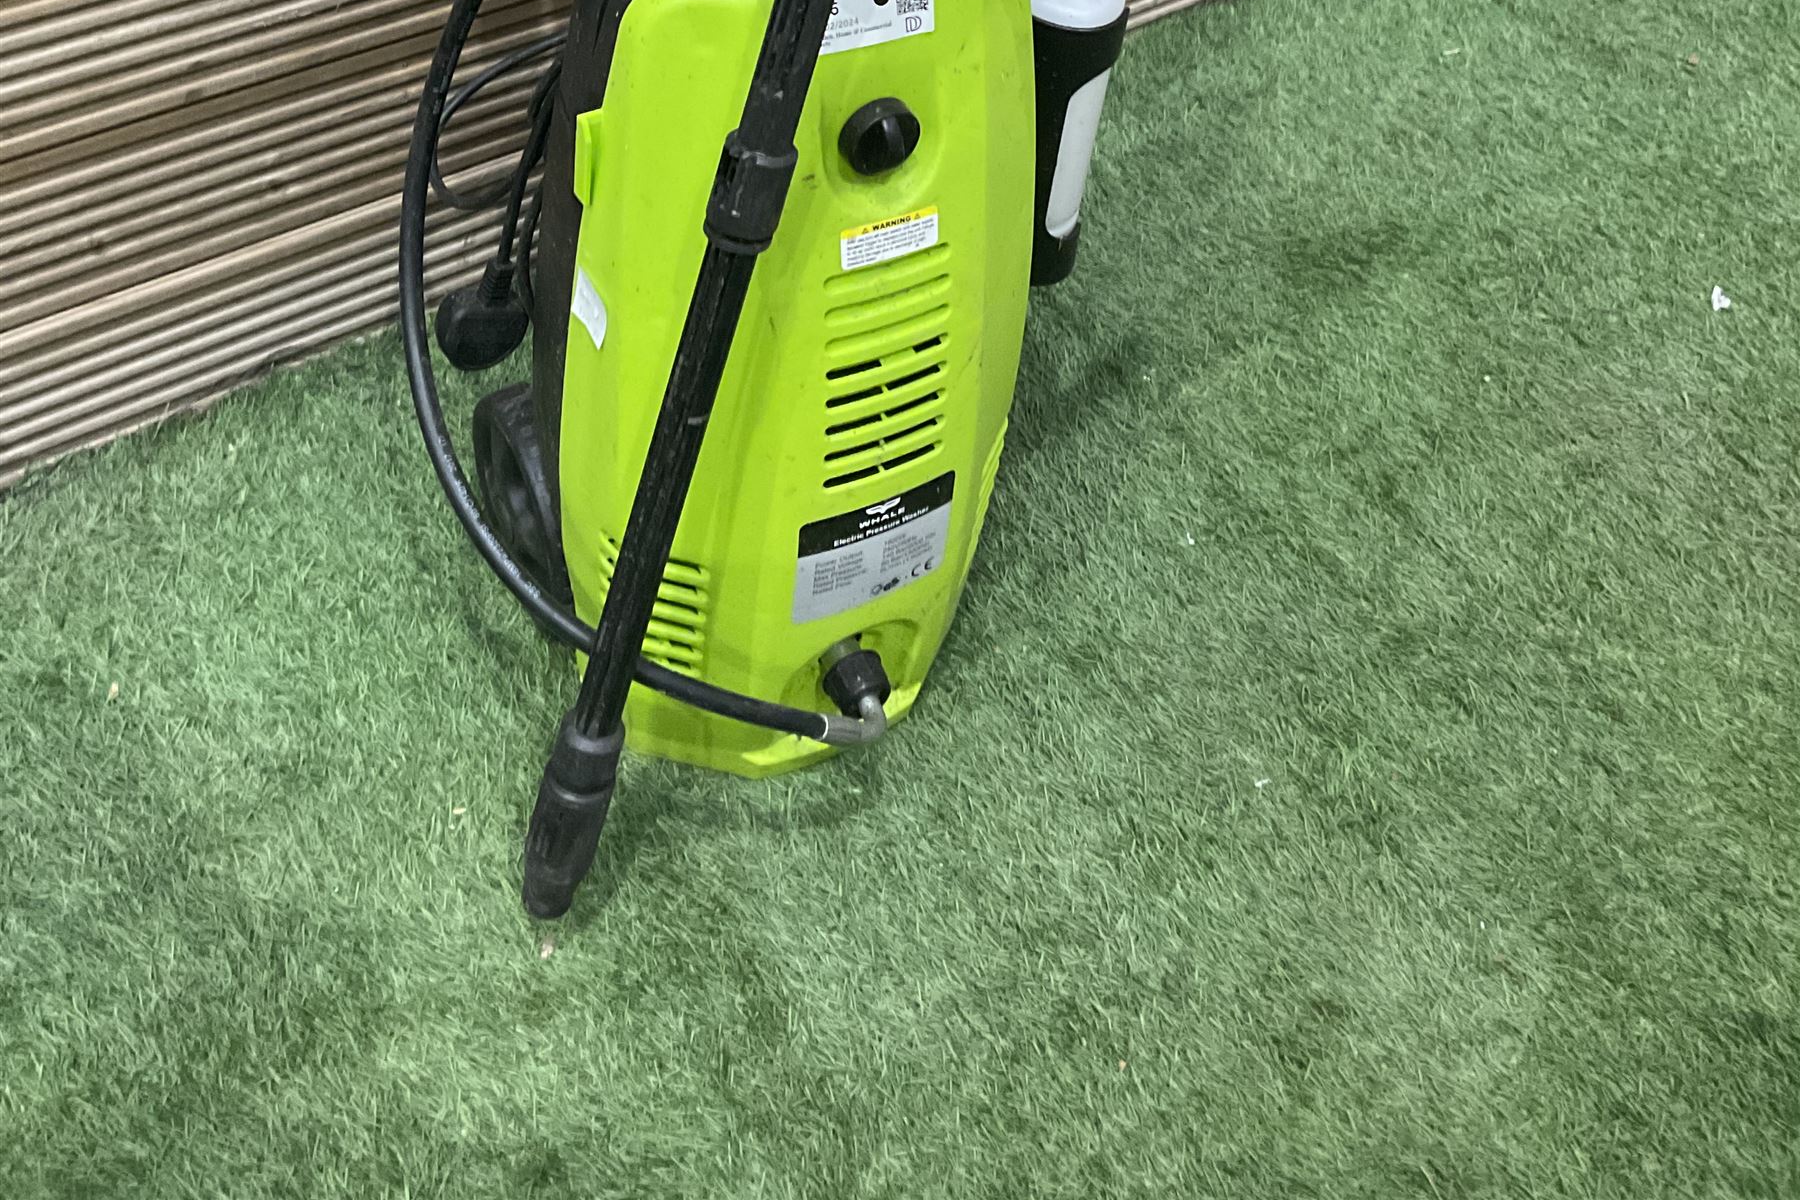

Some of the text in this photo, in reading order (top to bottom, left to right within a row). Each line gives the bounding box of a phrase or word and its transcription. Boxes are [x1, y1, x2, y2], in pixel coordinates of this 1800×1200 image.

[872, 215, 911, 231] WARNING
[833, 533, 864, 547] Electric
[866, 520, 900, 537] Pressure
[902, 506, 929, 523] Washer
[859, 506, 905, 529] WHALE
